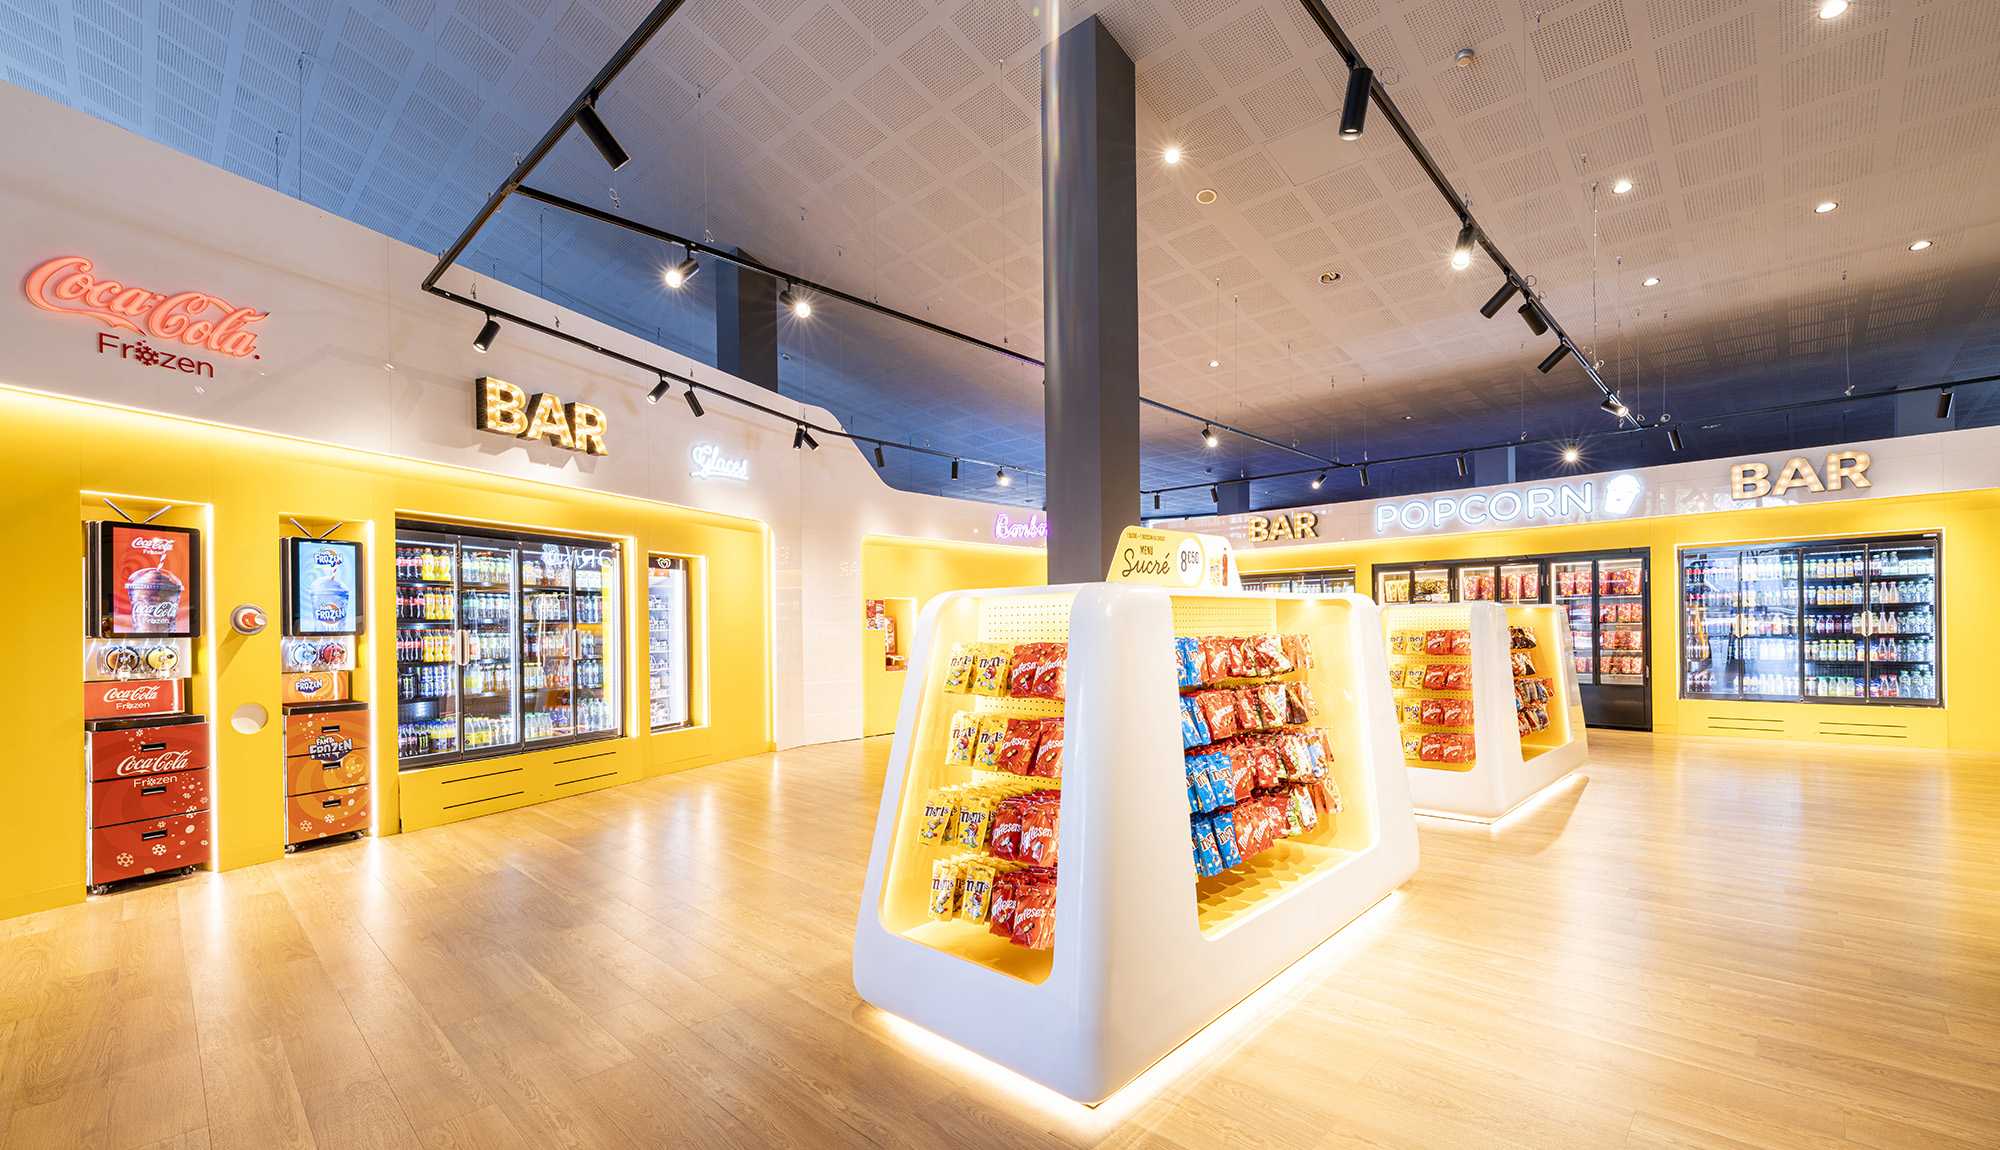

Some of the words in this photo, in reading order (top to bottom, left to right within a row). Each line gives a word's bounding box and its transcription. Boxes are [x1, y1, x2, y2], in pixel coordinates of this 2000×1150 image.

[25, 256, 270, 358] Coca-Cola
[97, 332, 214, 378] Frozen
[476, 376, 608, 456] BAR
[1730, 450, 1872, 500] BAR
[1376, 482, 1593, 532] POPCORN
[1249, 512, 1319, 542] BAR
[1122, 548, 1170, 577] Sucré
[103, 685, 160, 702] Coca-Cola
[117, 750, 192, 776] Coca-Cola
[134, 775, 177, 788] Frozen
